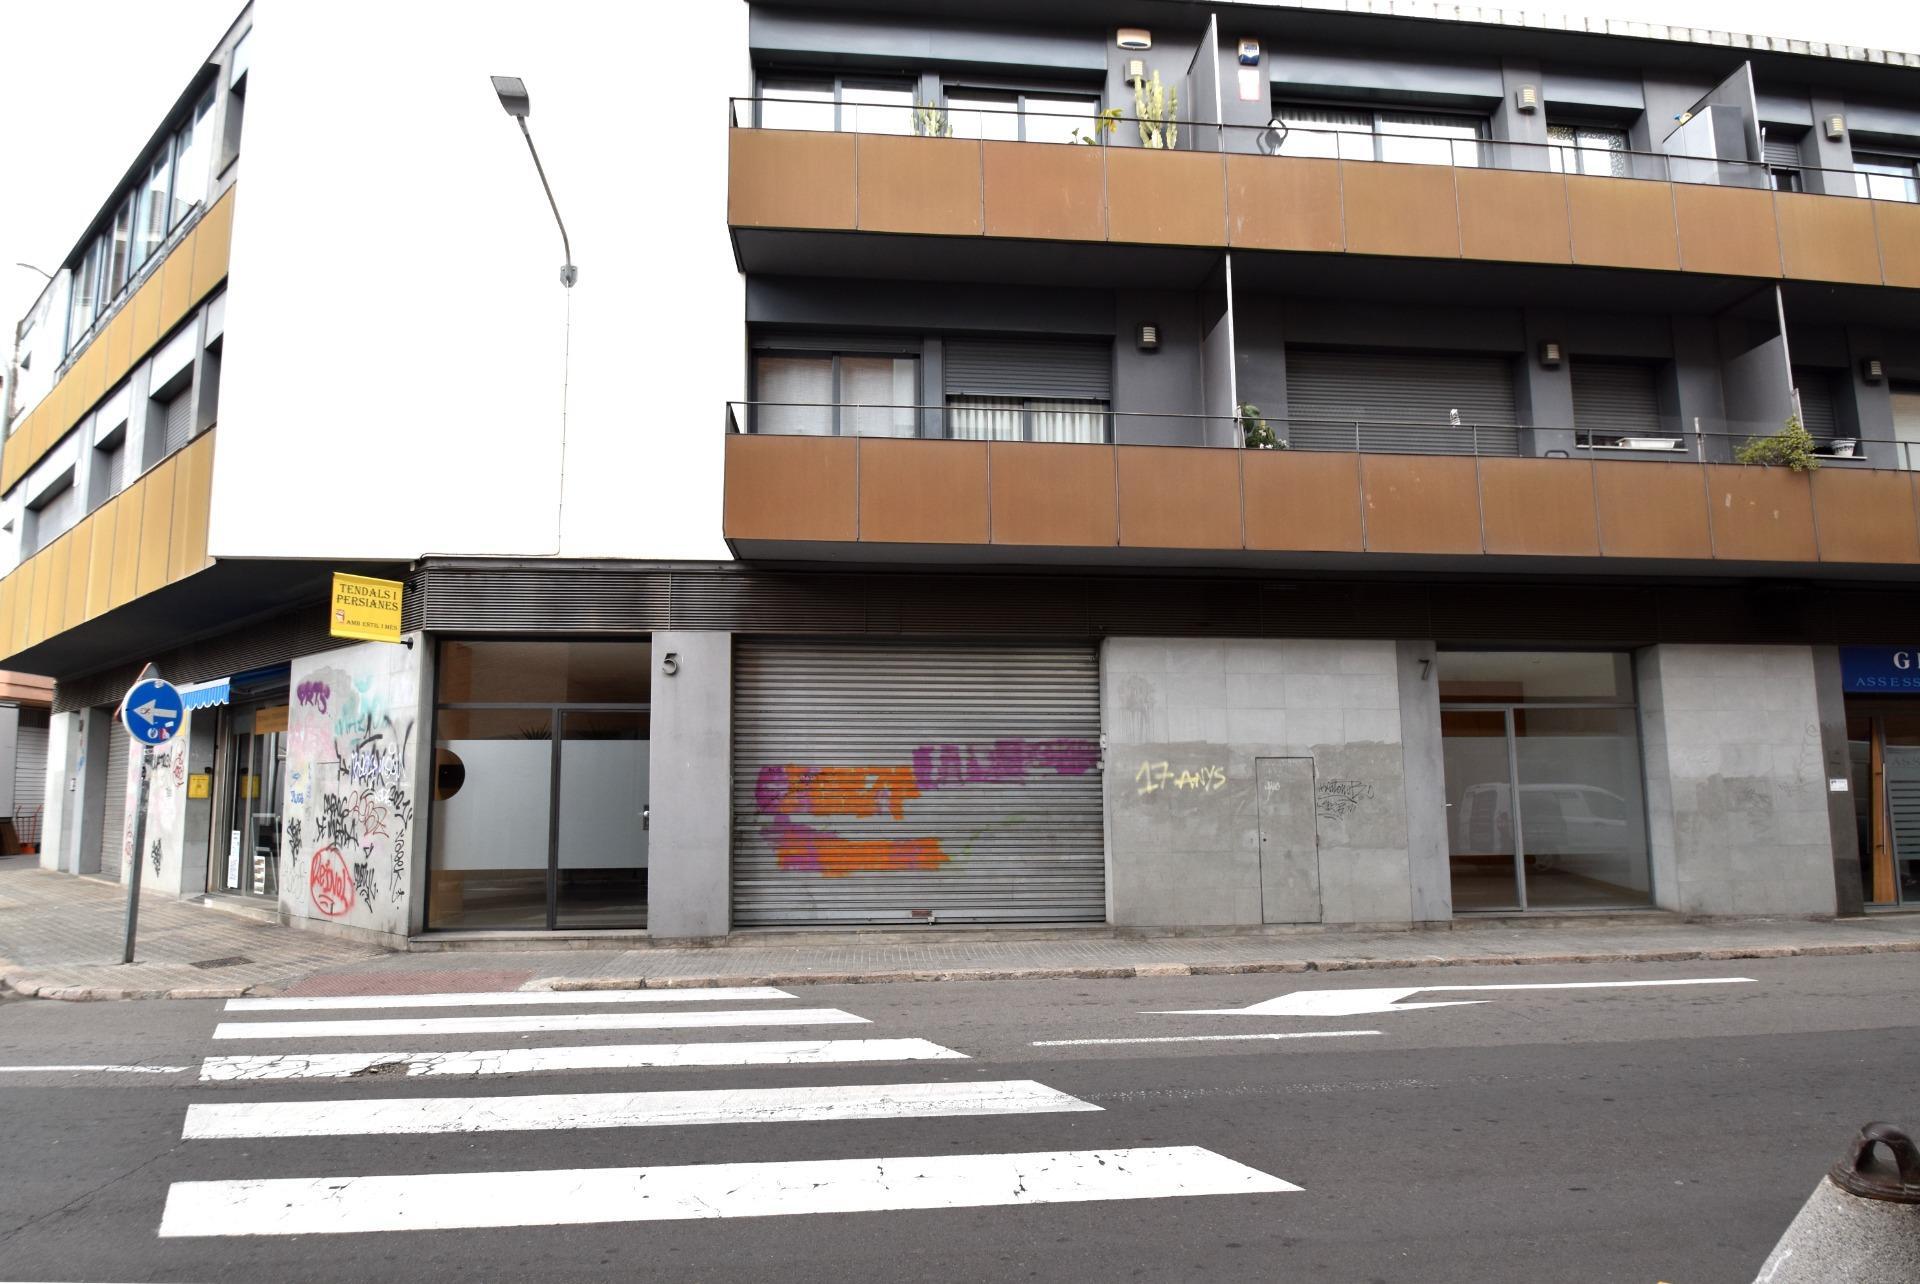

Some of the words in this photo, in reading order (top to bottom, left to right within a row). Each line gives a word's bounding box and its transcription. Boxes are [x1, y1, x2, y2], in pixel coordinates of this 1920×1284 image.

[340, 584, 390, 599] TENDALS
[393, 591, 397, 600] I
[337, 595, 398, 611] PERSIANES
[662, 652, 679, 677] 5
[1418, 659, 1431, 680] 7
[1136, 760, 1173, 795] 17
